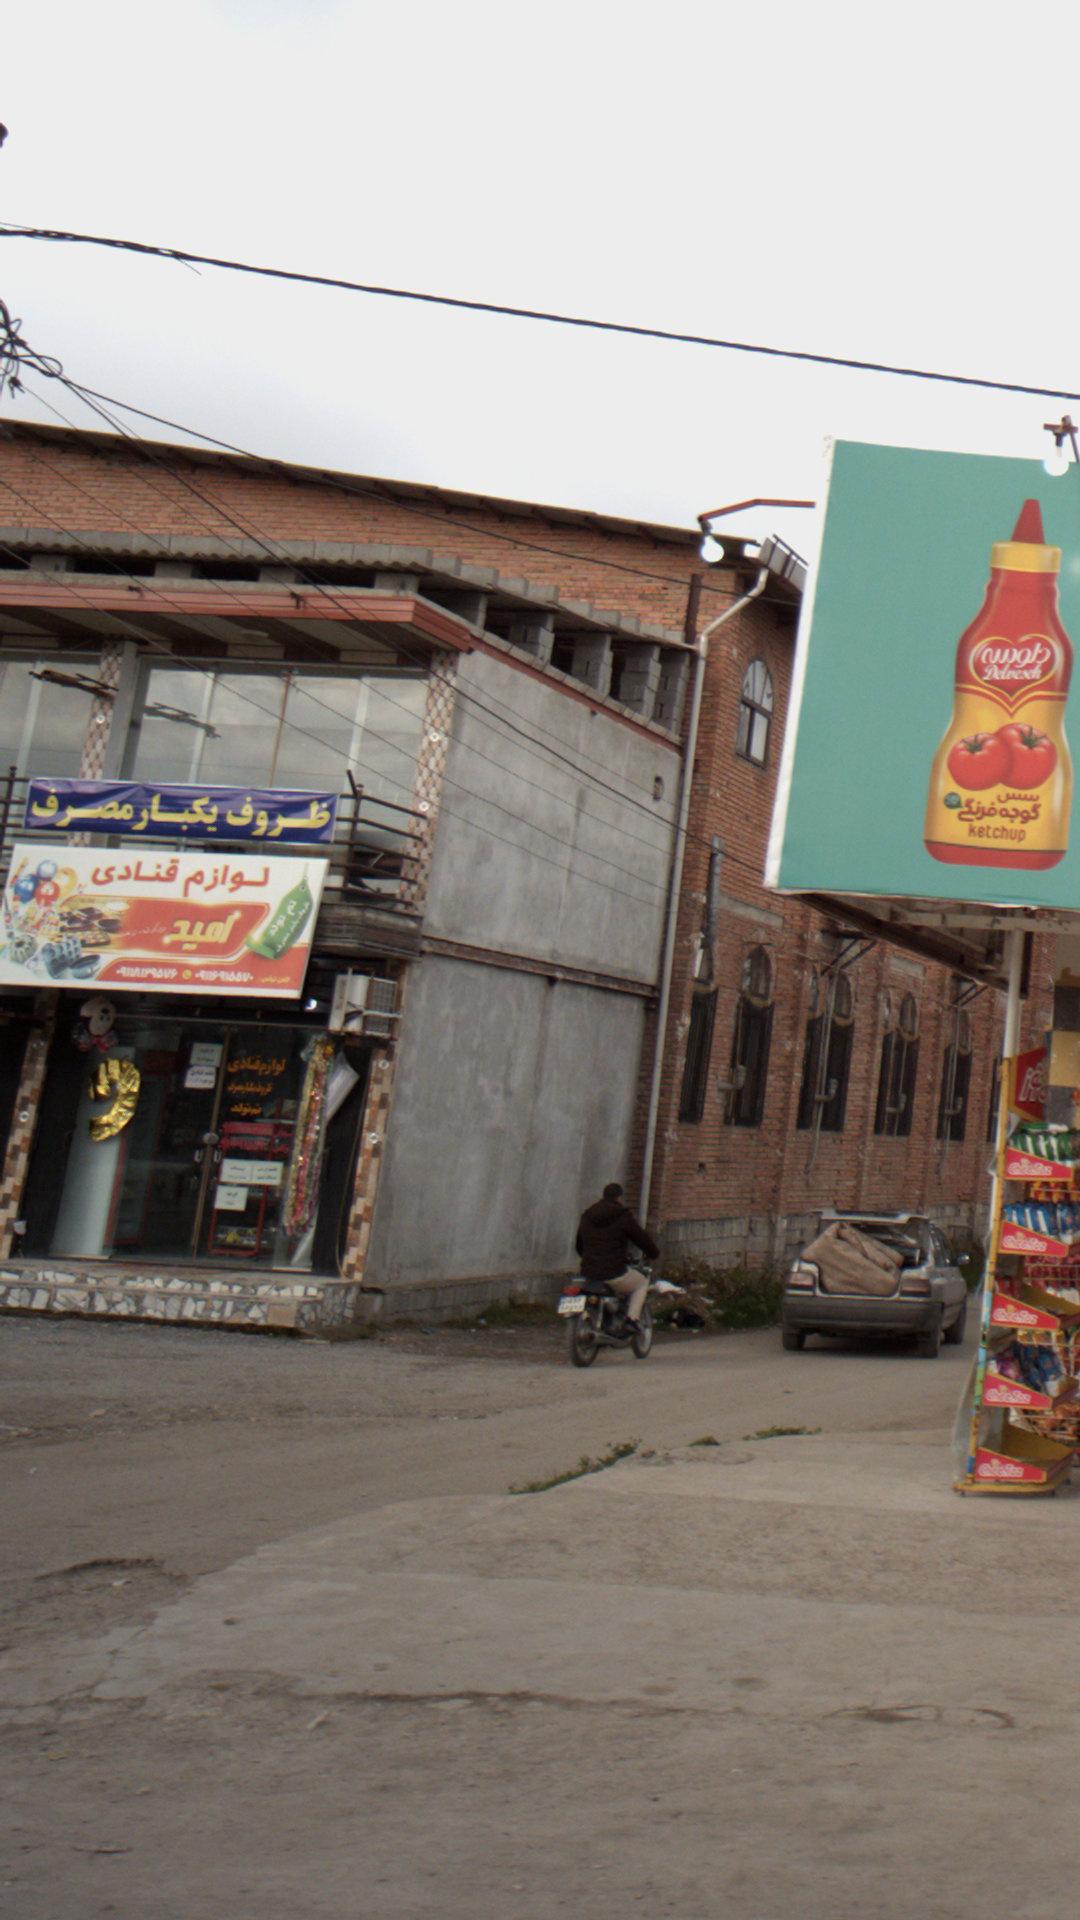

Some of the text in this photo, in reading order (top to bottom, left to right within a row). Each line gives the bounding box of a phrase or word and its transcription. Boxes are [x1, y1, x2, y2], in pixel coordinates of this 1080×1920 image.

[31, 788, 331, 837] ظروف یکبار مصرف
[957, 798, 1041, 824] گوجه فرنگی
[968, 823, 1026, 842] ketchup
[91, 859, 271, 897] لوازم قنادی
[162, 909, 241, 951] امید
